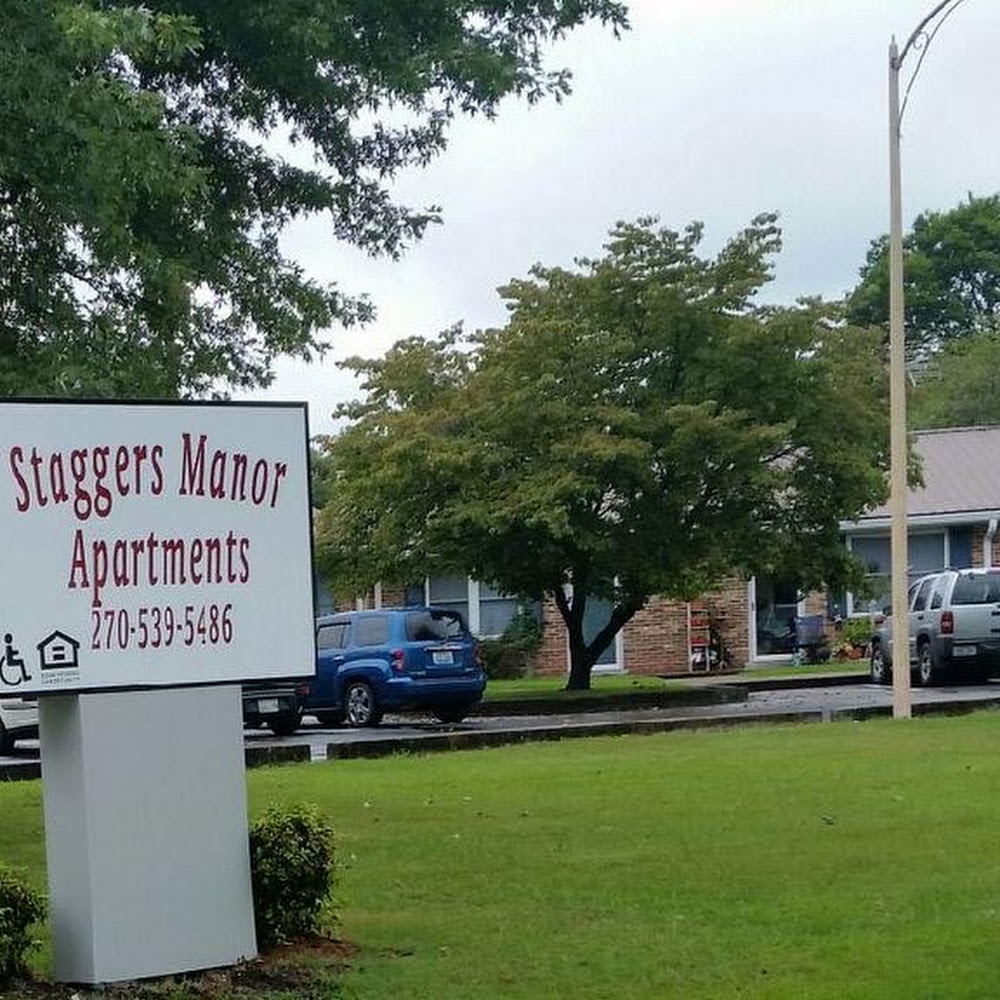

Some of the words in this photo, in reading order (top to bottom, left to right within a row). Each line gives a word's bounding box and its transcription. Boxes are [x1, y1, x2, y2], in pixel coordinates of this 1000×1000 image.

[10, 446, 163, 520] Staggers
[179, 433, 286, 508] Manor
[68, 530, 250, 607] Apartments
[91, 604, 233, 650] 270-539-5486
